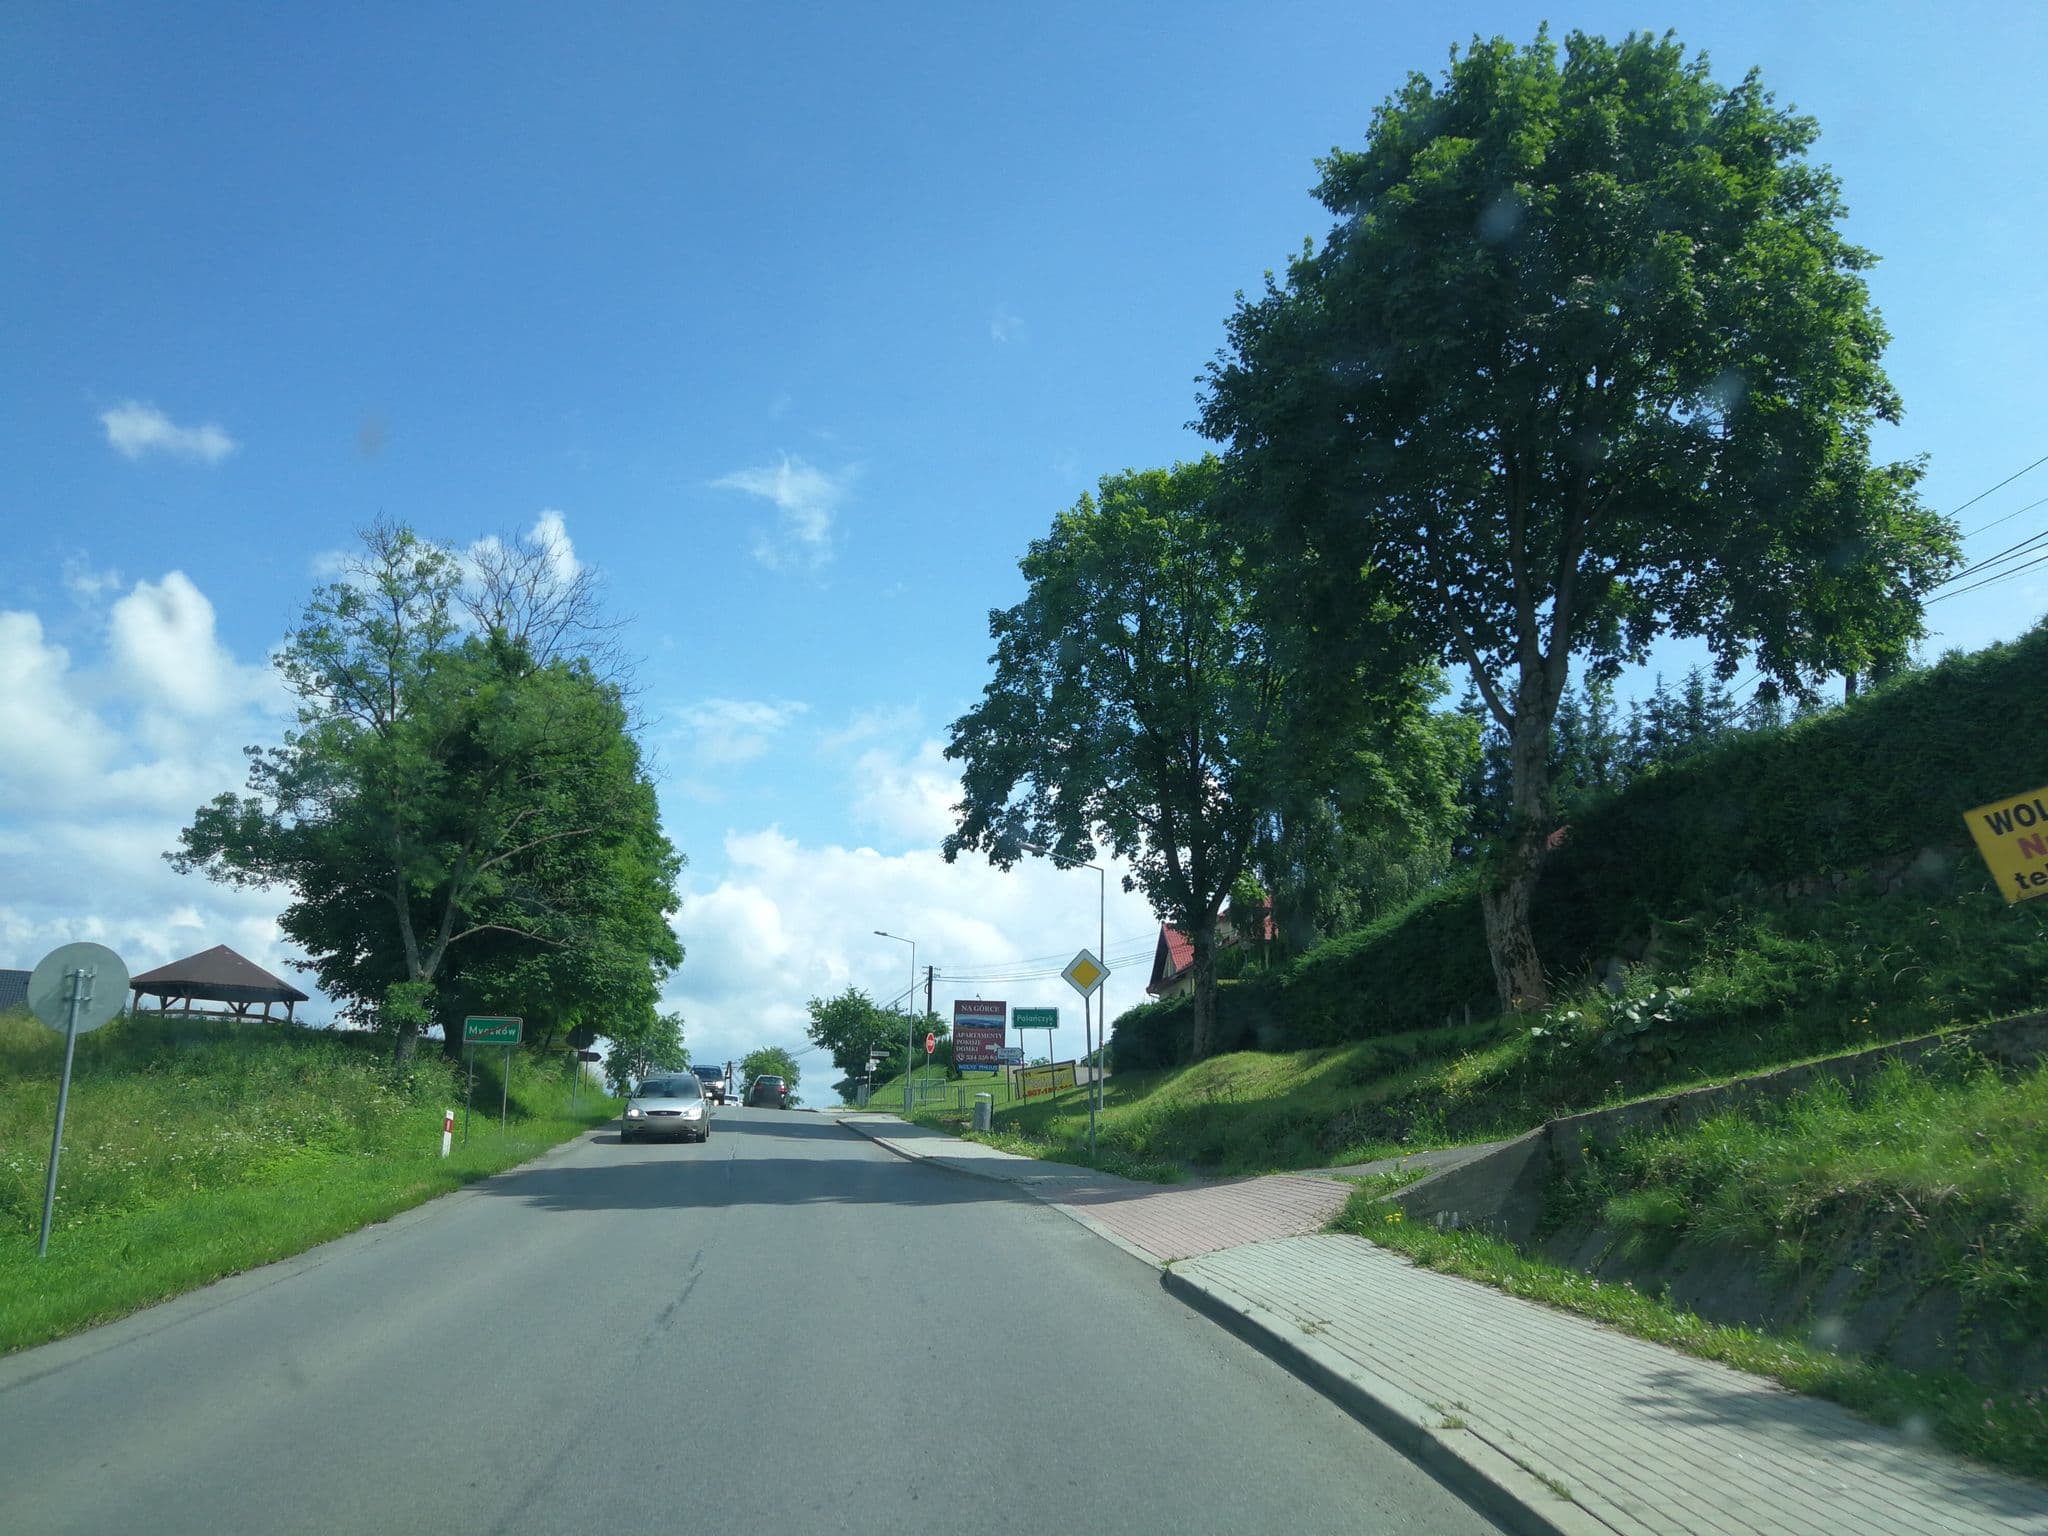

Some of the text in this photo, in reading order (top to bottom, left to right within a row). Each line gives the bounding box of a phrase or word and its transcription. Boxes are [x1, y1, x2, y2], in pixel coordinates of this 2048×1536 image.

[2017, 833, 2048, 859] N
[961, 1004, 973, 1012] NA
[1016, 1014, 1054, 1025] Polańczyk
